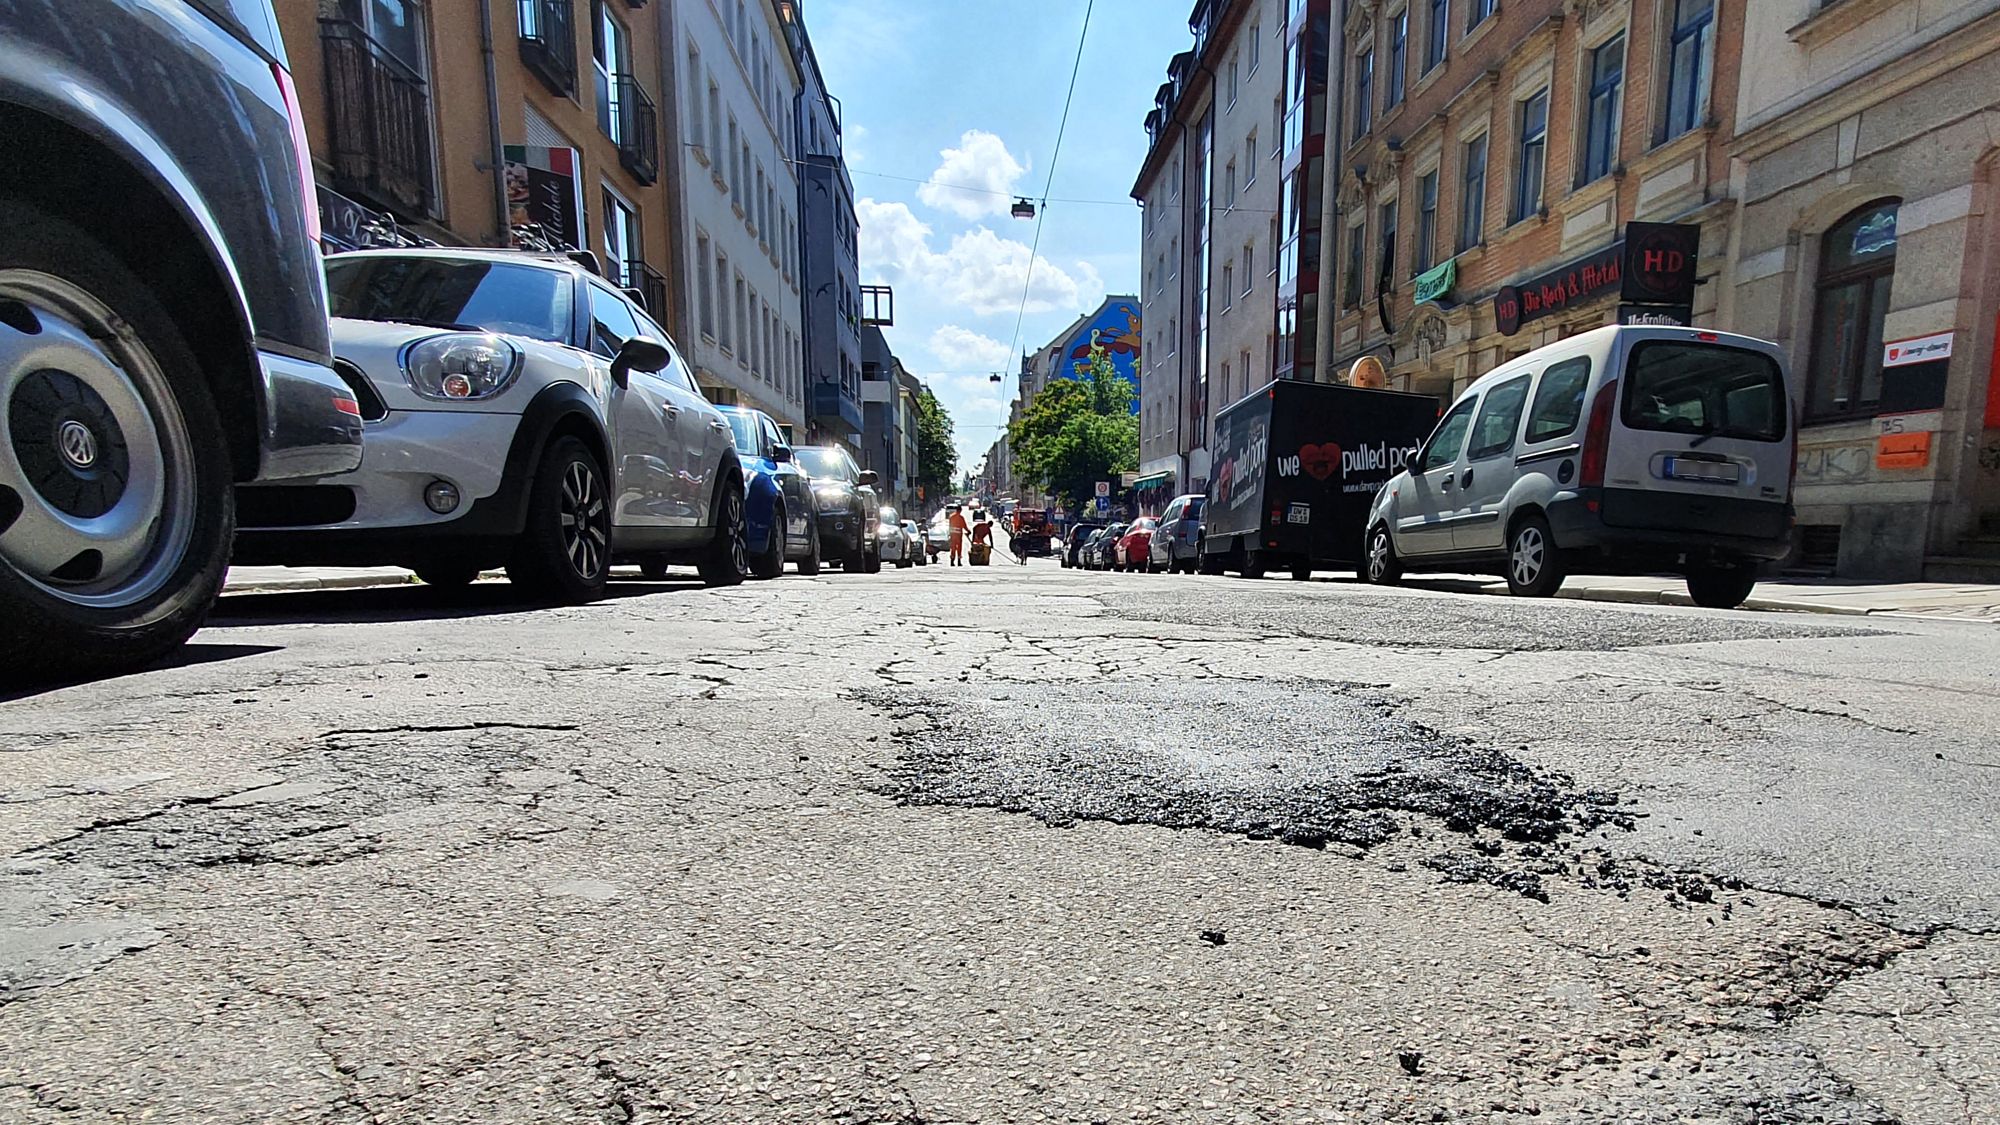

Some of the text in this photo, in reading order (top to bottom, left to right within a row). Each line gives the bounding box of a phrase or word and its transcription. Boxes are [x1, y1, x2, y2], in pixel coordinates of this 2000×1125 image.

[1643, 249, 1684, 273] HD
[1499, 300, 1516, 319] HD
[1567, 272, 1580, 298] &
[1582, 255, 1620, 295] Metal
[1277, 455, 1300, 477] we
[1342, 440, 1385, 479] pulled
